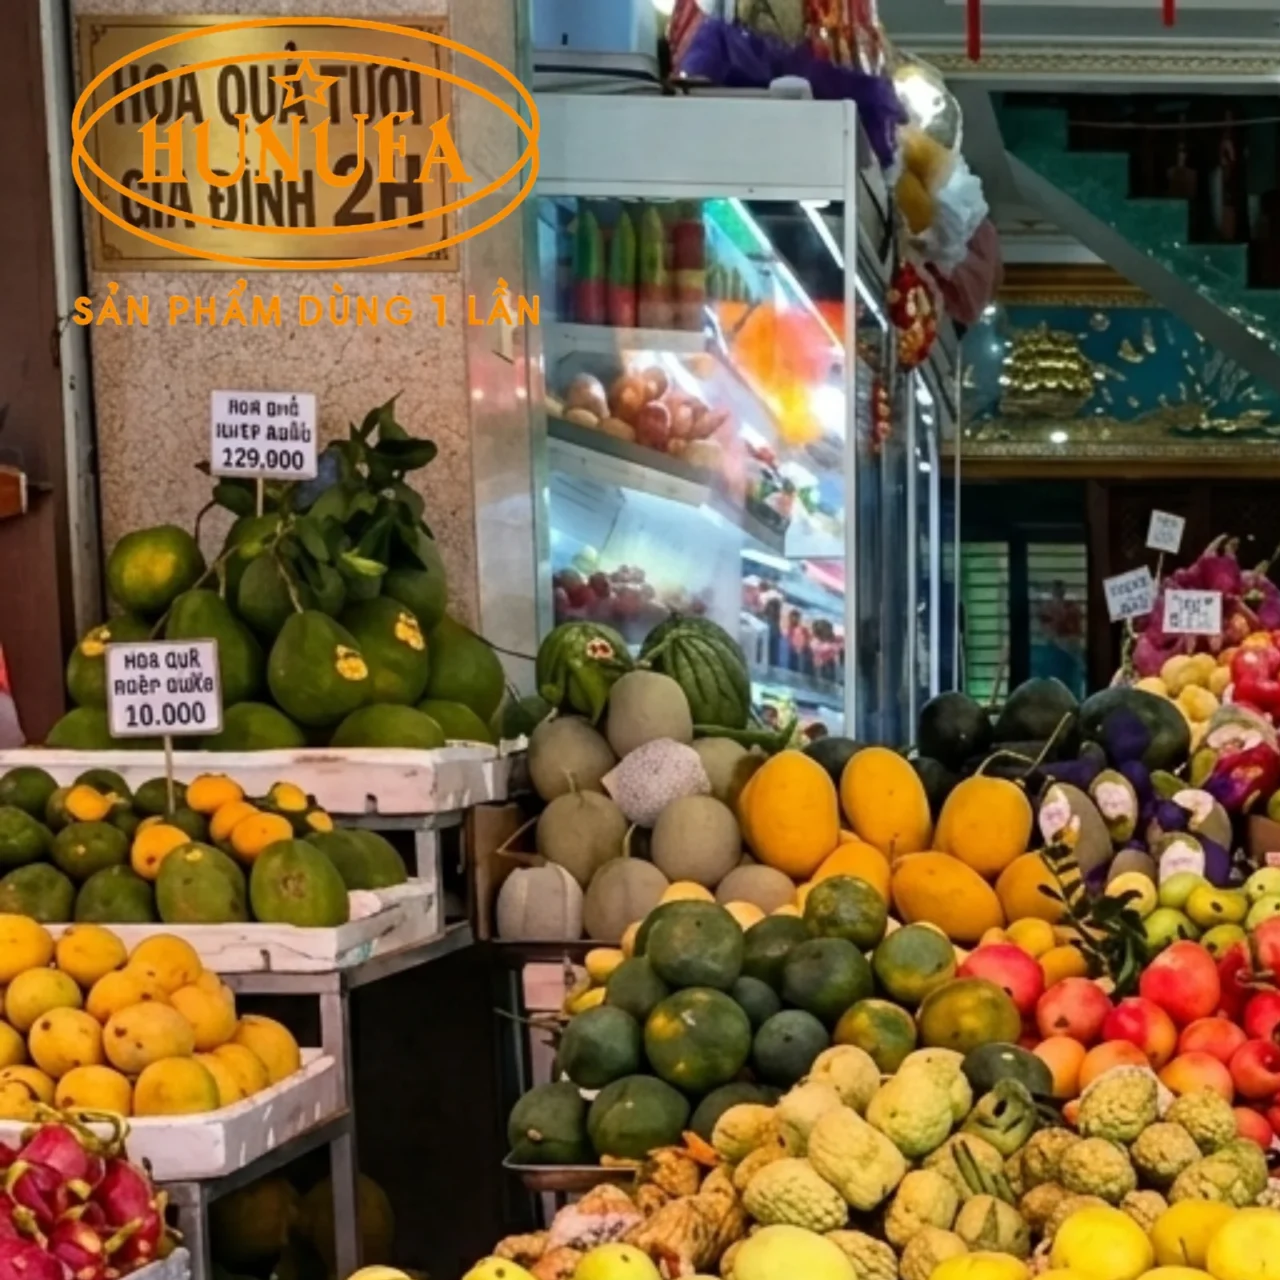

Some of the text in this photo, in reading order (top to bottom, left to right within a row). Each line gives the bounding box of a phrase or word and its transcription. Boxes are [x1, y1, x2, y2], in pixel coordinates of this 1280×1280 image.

[114, 63, 203, 125] HOA
[217, 41, 309, 135] QUẢ
[121, 168, 196, 228] GIA
[332, 153, 424, 229] 2H
[126, 701, 206, 727] 10.000
